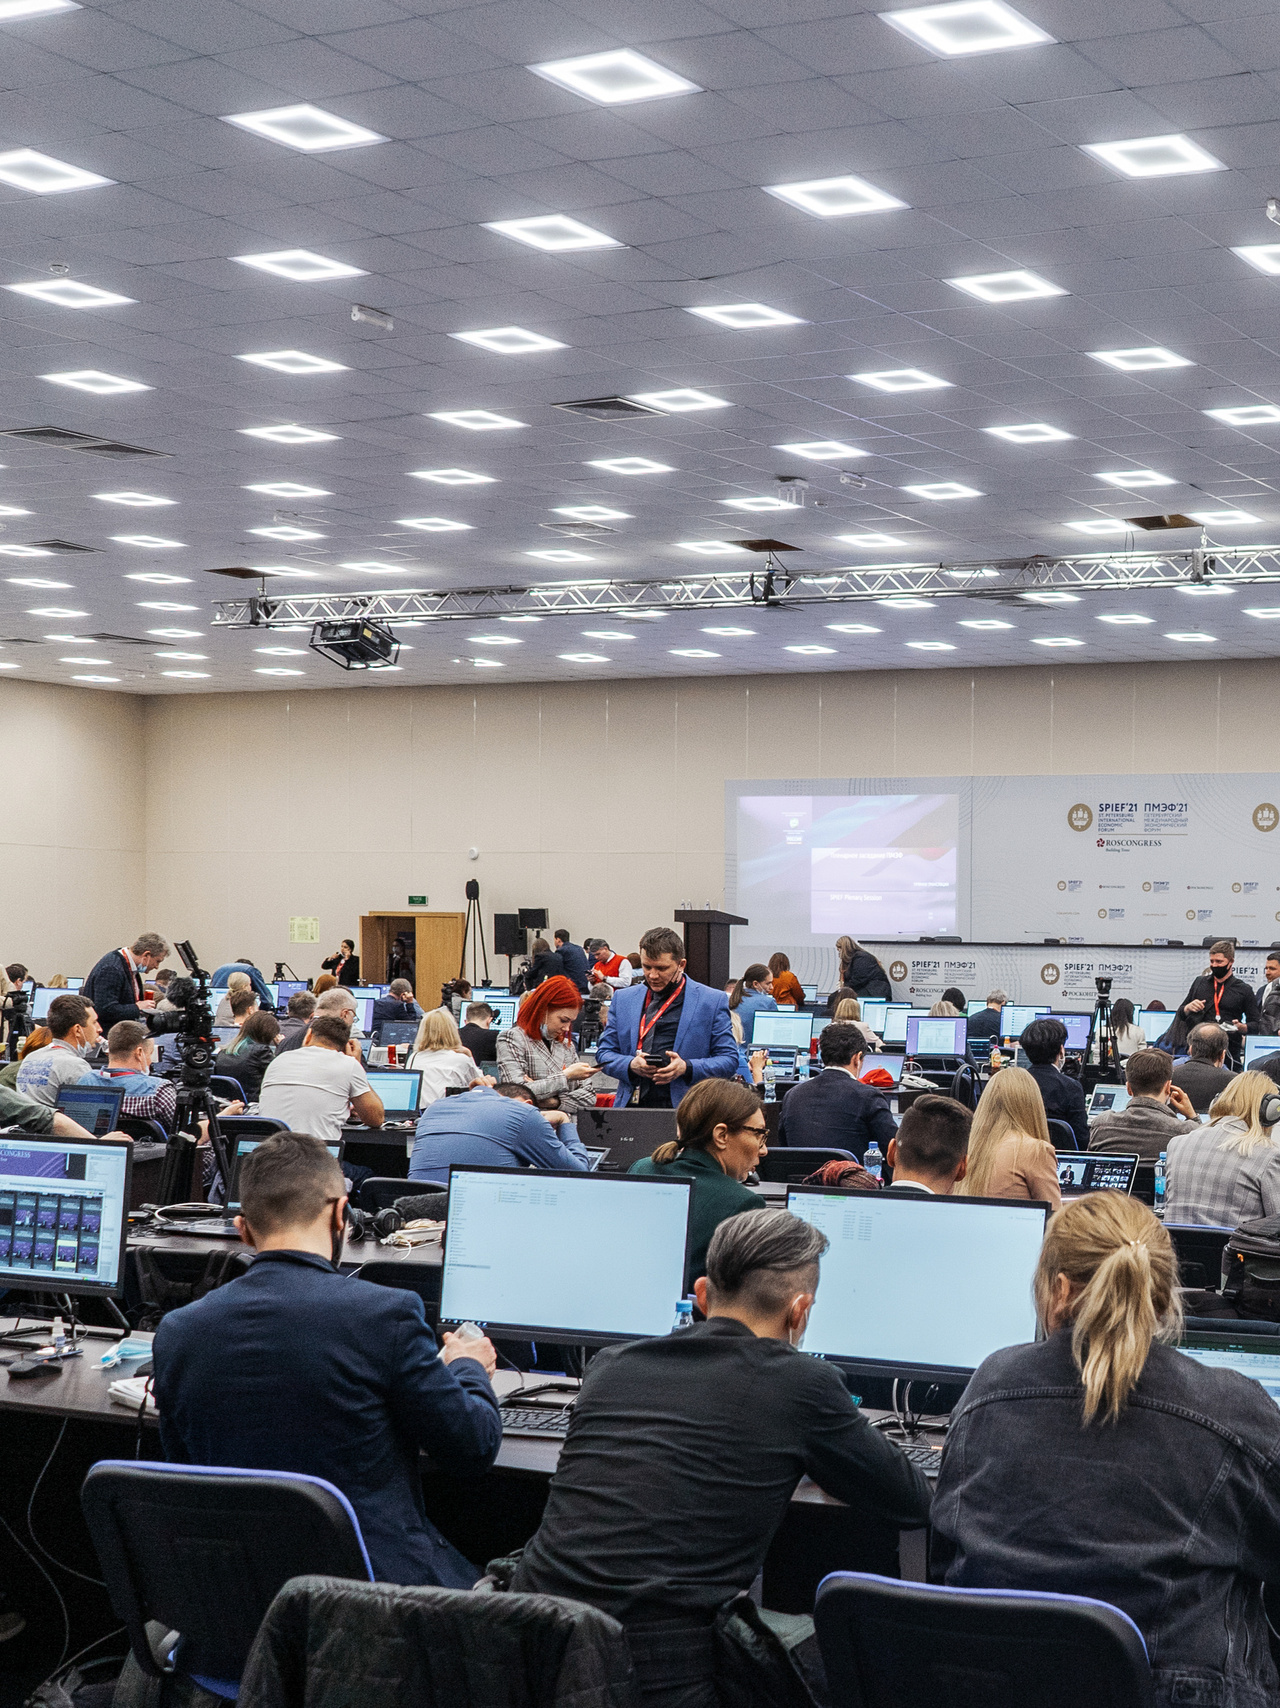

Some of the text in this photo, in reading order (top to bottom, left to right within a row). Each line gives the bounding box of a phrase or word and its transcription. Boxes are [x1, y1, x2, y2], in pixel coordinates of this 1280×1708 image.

[1099, 803, 1138, 812] SPIEF'21
[1144, 803, 1188, 812] ПМЭФ'21
[1106, 839, 1162, 847] ROSCONGRESS
[944, 961, 976, 969] ПМЭФ'21
[1099, 964, 1132, 972] ПМЭФ'21
[0, 1149, 31, 1158] CONGRESS
